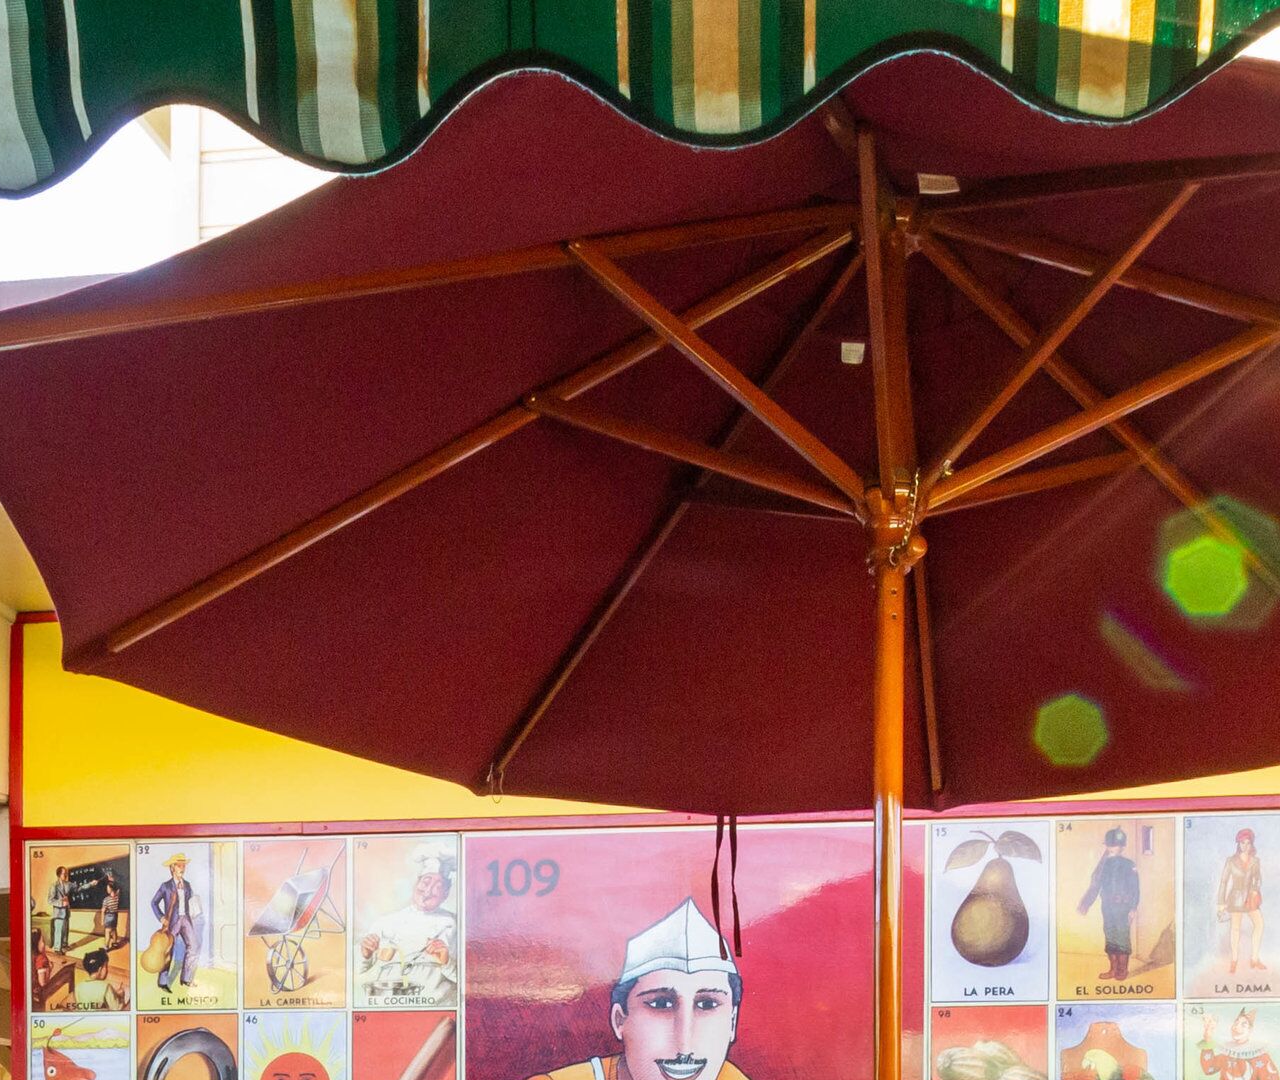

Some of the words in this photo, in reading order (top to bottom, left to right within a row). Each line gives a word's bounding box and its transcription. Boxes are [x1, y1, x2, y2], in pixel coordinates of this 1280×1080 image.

[1059, 822, 1073, 833] 34
[1186, 819, 1192, 829] 3
[935, 827, 947, 837] 15
[138, 845, 150, 855] 32
[357, 841, 368, 850] 79
[486, 858, 560, 898] 109
[963, 987, 979, 997] LA
[983, 985, 1015, 997] PERA
[1076, 986, 1090, 996] EL
[1095, 985, 1154, 996] SOLDADO
[1214, 984, 1231, 994] LA
[1235, 983, 1272, 993] DAMA
[161, 996, 173, 1005] EL
[177, 995, 218, 1005] MUSICO
[260, 998, 271, 1007] LA
[368, 996, 379, 1005] EL
[383, 996, 436, 1005] COCINERO
[50, 1002, 62, 1011] LA
[66, 1002, 107, 1010] ESCUELA
[1190, 1006, 1204, 1016] 63
[938, 1009, 951, 1019] 98
[1058, 1008, 1073, 1018] 24
[33, 1019, 45, 1029] 50
[143, 1016, 160, 1024] 100
[246, 1015, 258, 1024] 46
[354, 1015, 366, 1024] 99
